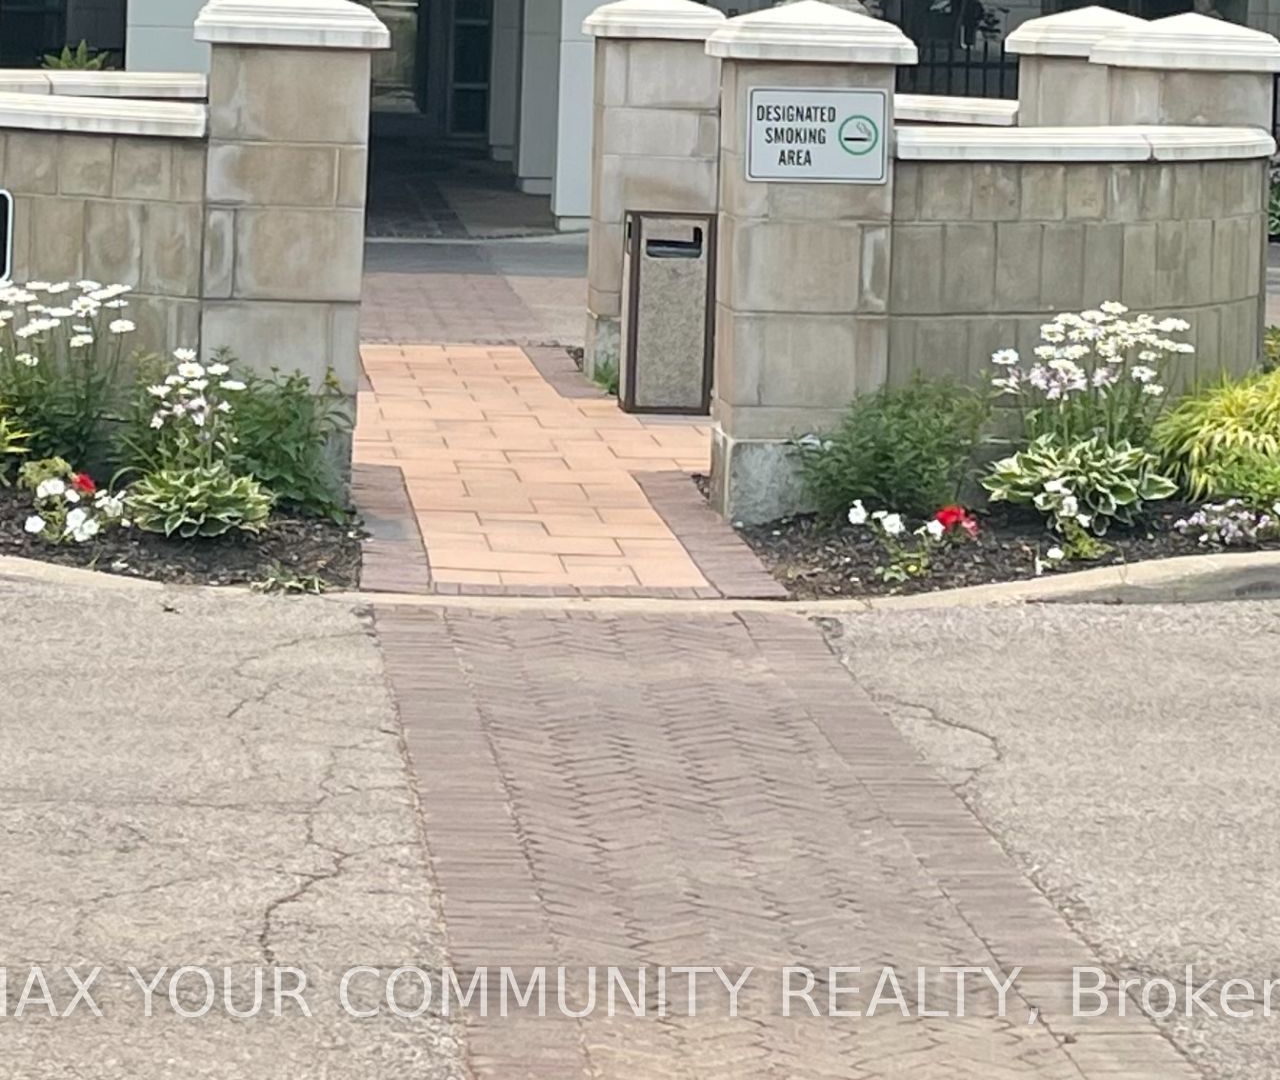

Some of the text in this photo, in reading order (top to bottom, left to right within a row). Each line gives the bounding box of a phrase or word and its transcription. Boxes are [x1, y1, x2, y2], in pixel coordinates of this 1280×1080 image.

[756, 104, 836, 123] DESIGNATED
[764, 127, 827, 145] SMOKING
[778, 149, 812, 167] AREA
